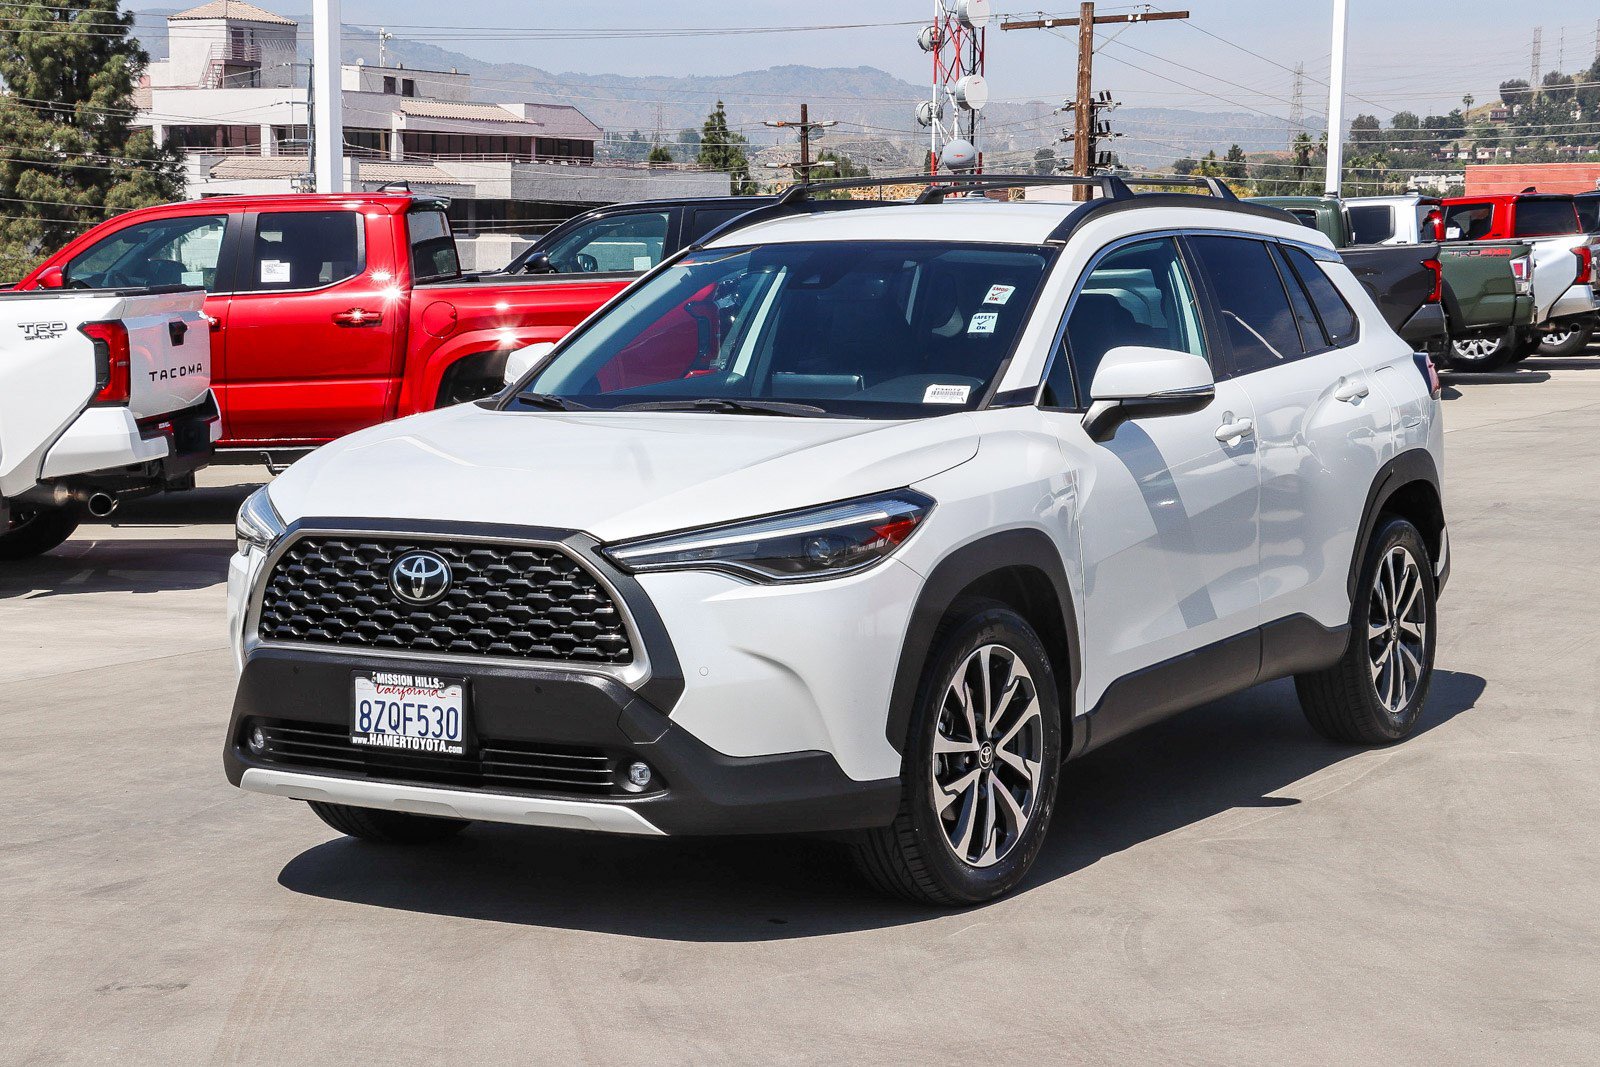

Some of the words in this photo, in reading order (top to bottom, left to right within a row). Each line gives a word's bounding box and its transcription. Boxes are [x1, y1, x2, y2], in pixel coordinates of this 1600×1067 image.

[17, 321, 68, 336] TRD
[24, 333, 63, 341] SPORT
[148, 363, 203, 382] TACOMA
[376, 672, 413, 687] MISSION
[415, 676, 440, 689] HILLS
[375, 683, 446, 701] California
[359, 699, 459, 740] 8ZQF530
[352, 733, 463, 755] www.HAMERTOYOTA.com
